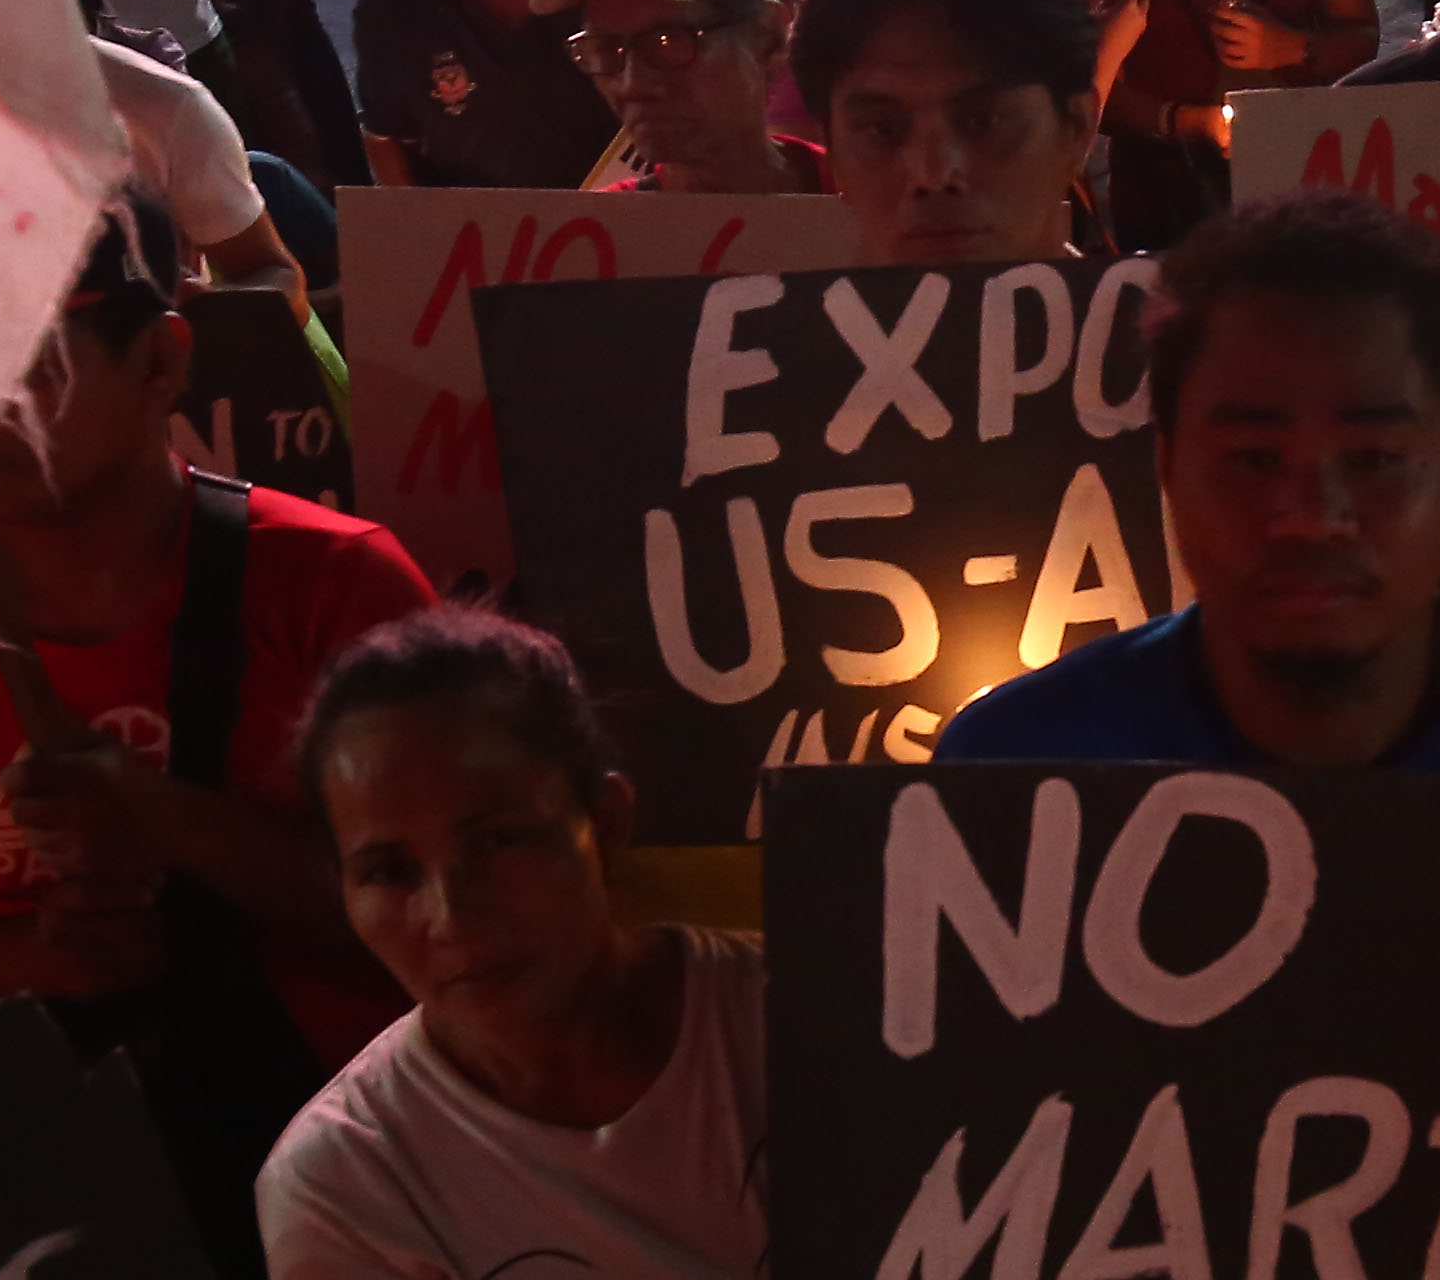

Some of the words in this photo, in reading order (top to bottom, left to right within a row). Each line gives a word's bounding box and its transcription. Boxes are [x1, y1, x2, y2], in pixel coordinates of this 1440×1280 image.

[265, 406, 333, 462] TO
[681, 256, 1166, 488] EXPO
[882, 769, 1318, 1060] NO
